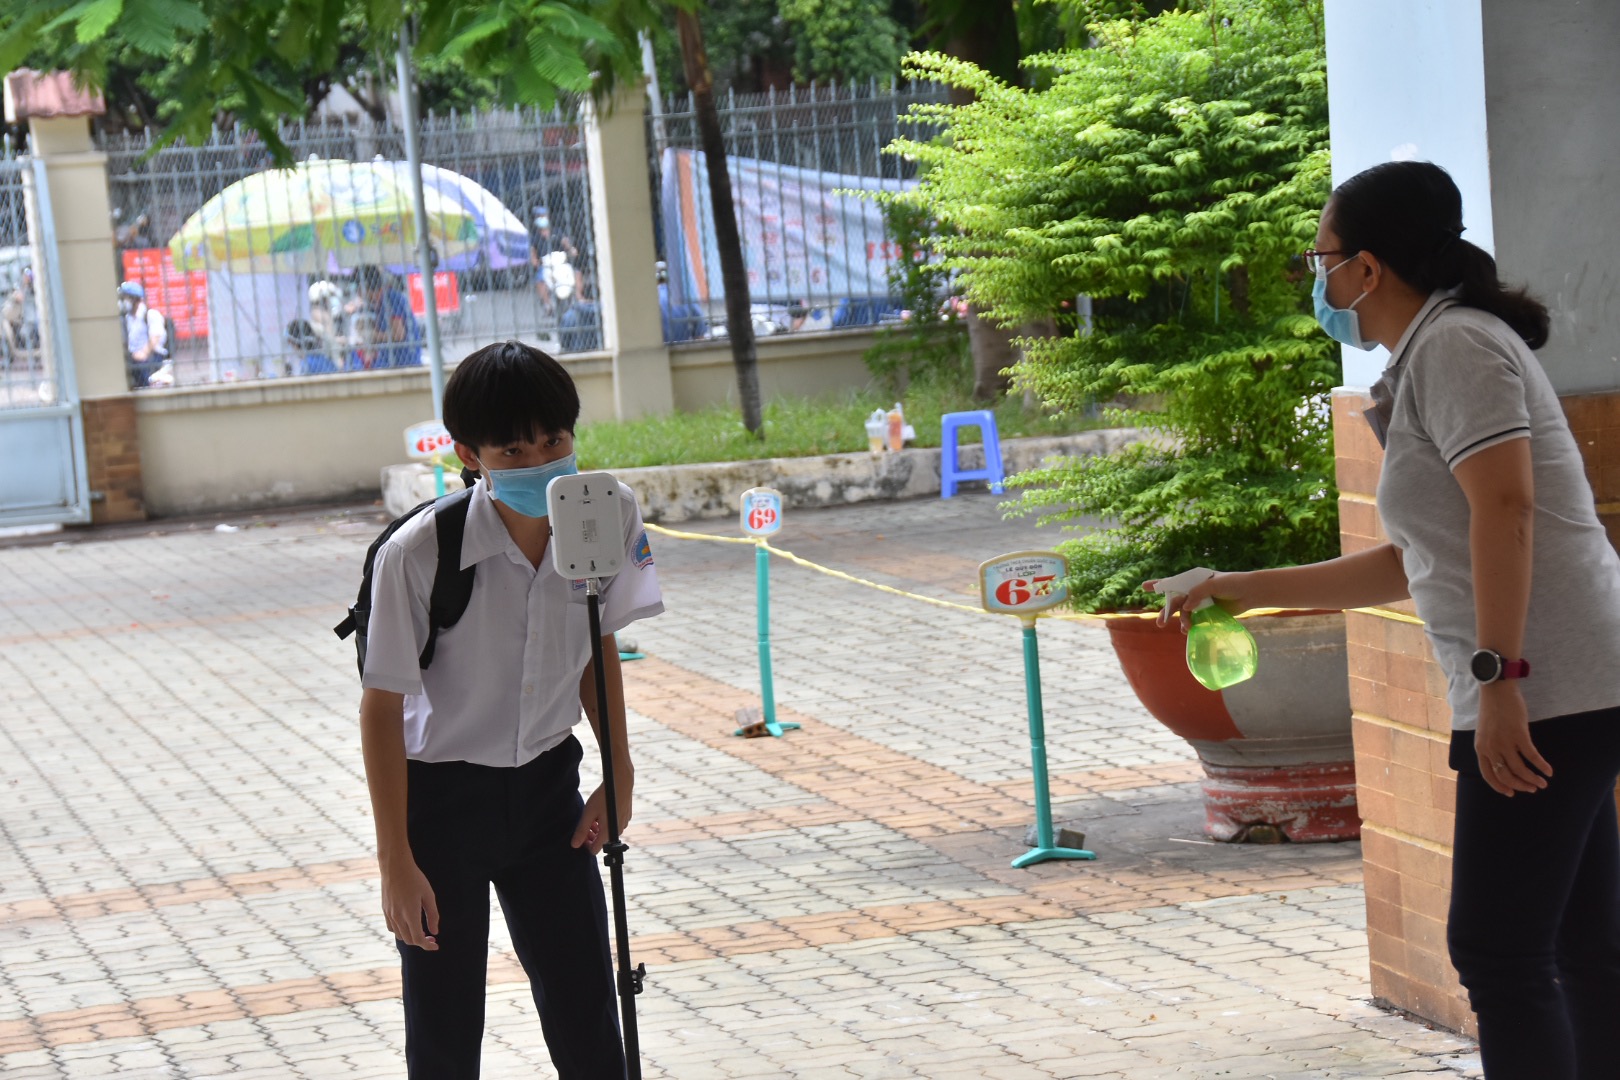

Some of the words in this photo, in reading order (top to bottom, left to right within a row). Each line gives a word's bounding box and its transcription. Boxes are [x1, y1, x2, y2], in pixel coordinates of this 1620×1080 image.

[416, 434, 452, 453] 66
[748, 508, 777, 530] 69
[995, 574, 1056, 605] 67
